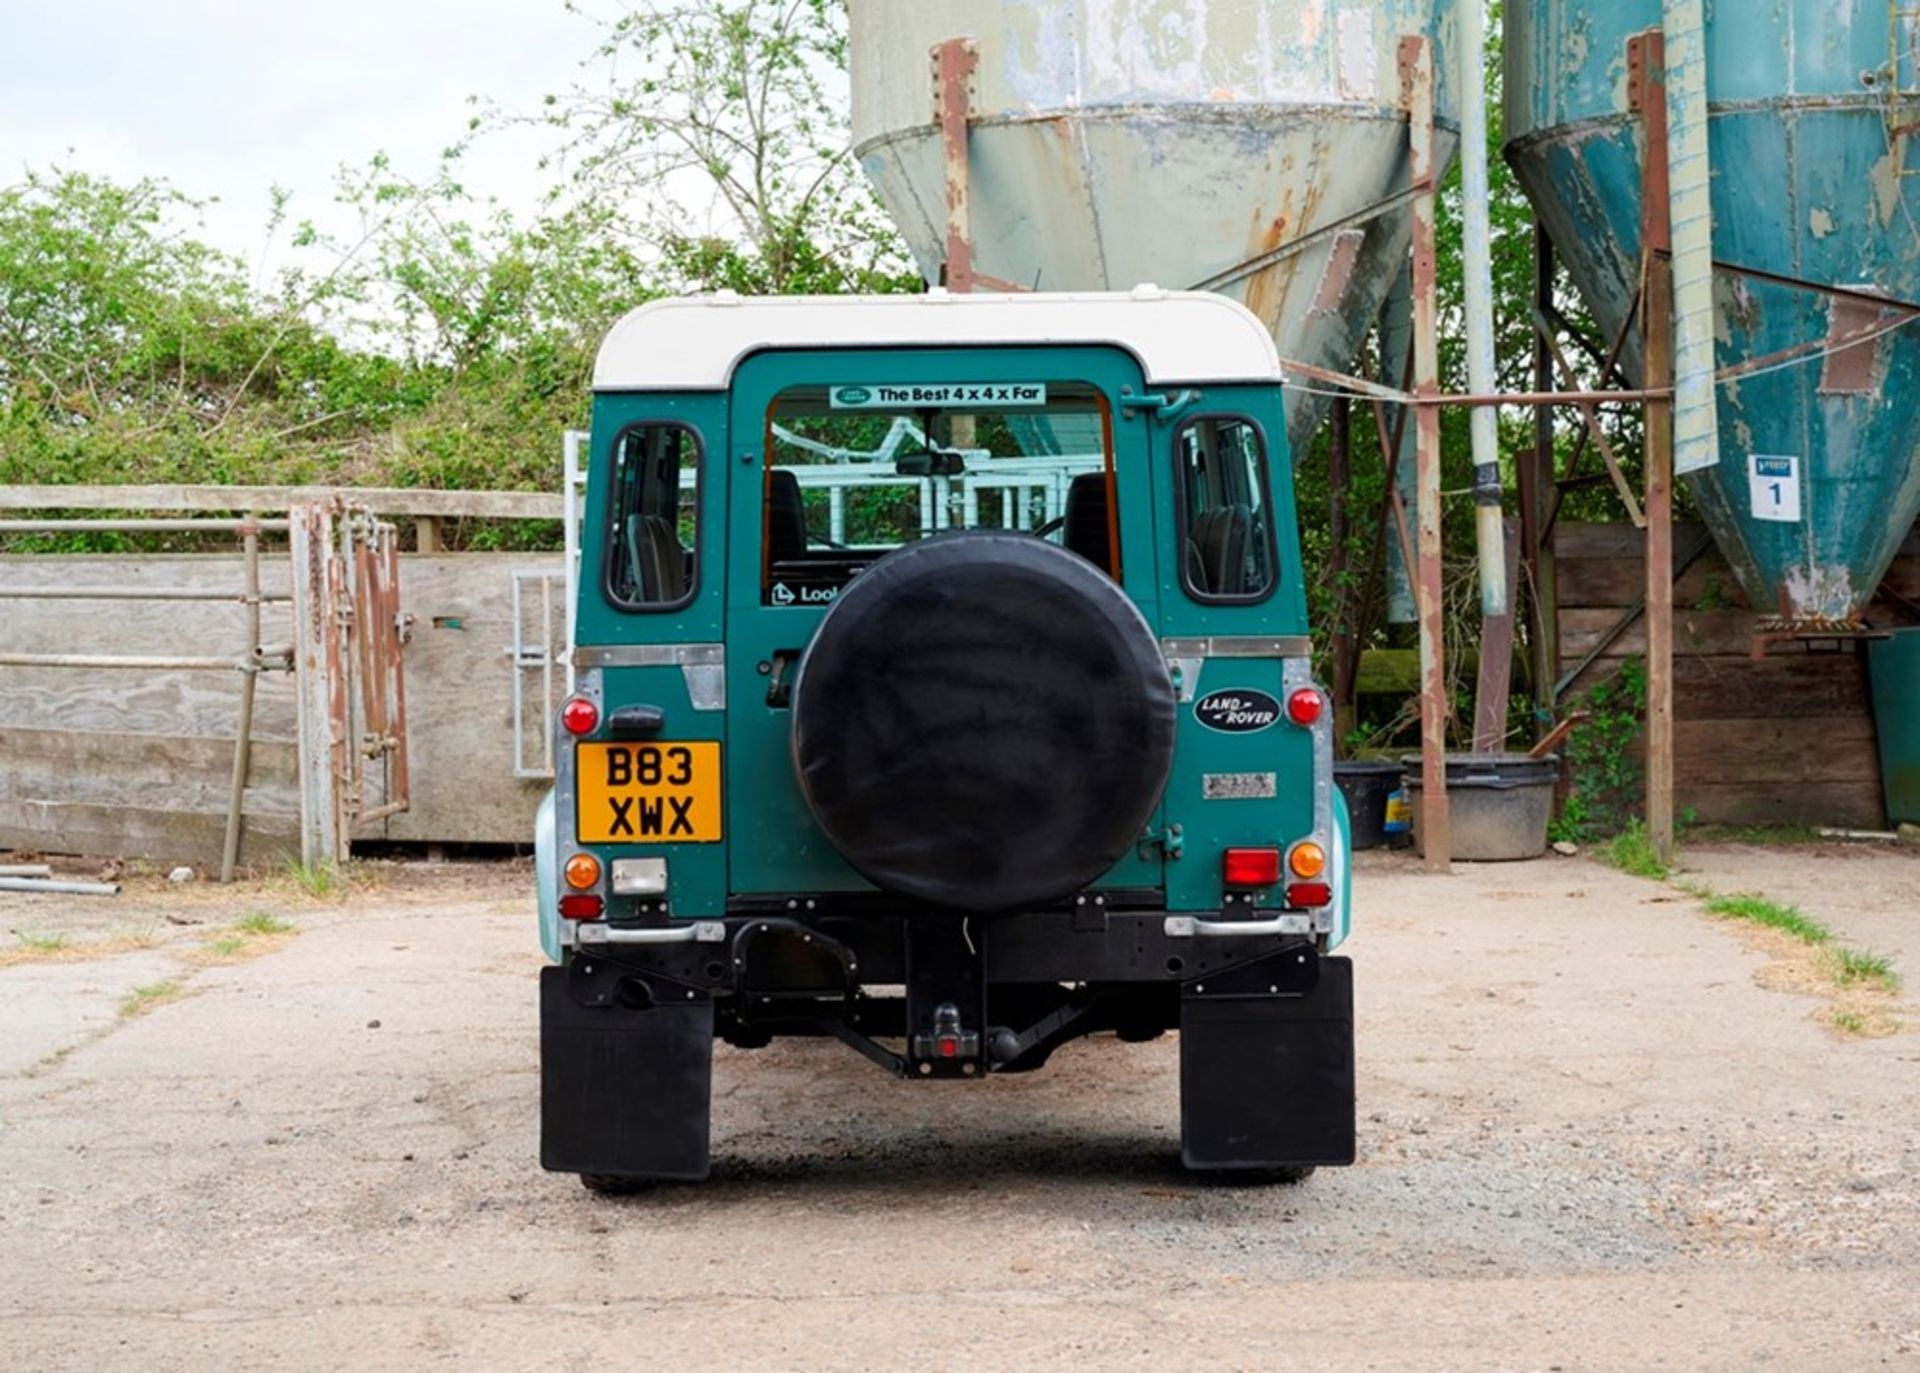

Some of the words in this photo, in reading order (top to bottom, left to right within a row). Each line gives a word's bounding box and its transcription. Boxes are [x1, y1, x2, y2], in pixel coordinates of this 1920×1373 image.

[878, 388, 909, 401] The
[912, 387, 949, 401] Best
[953, 387, 964, 400] 4
[967, 389, 979, 400] x
[982, 387, 993, 400] 4
[997, 389, 1009, 400] x
[1012, 386, 1039, 400] Far
[1768, 482, 1780, 505] 1
[1202, 698, 1240, 710] LAND
[1226, 712, 1273, 724] ROVER
[607, 747, 692, 785] B83
[608, 797, 693, 835] XWX
